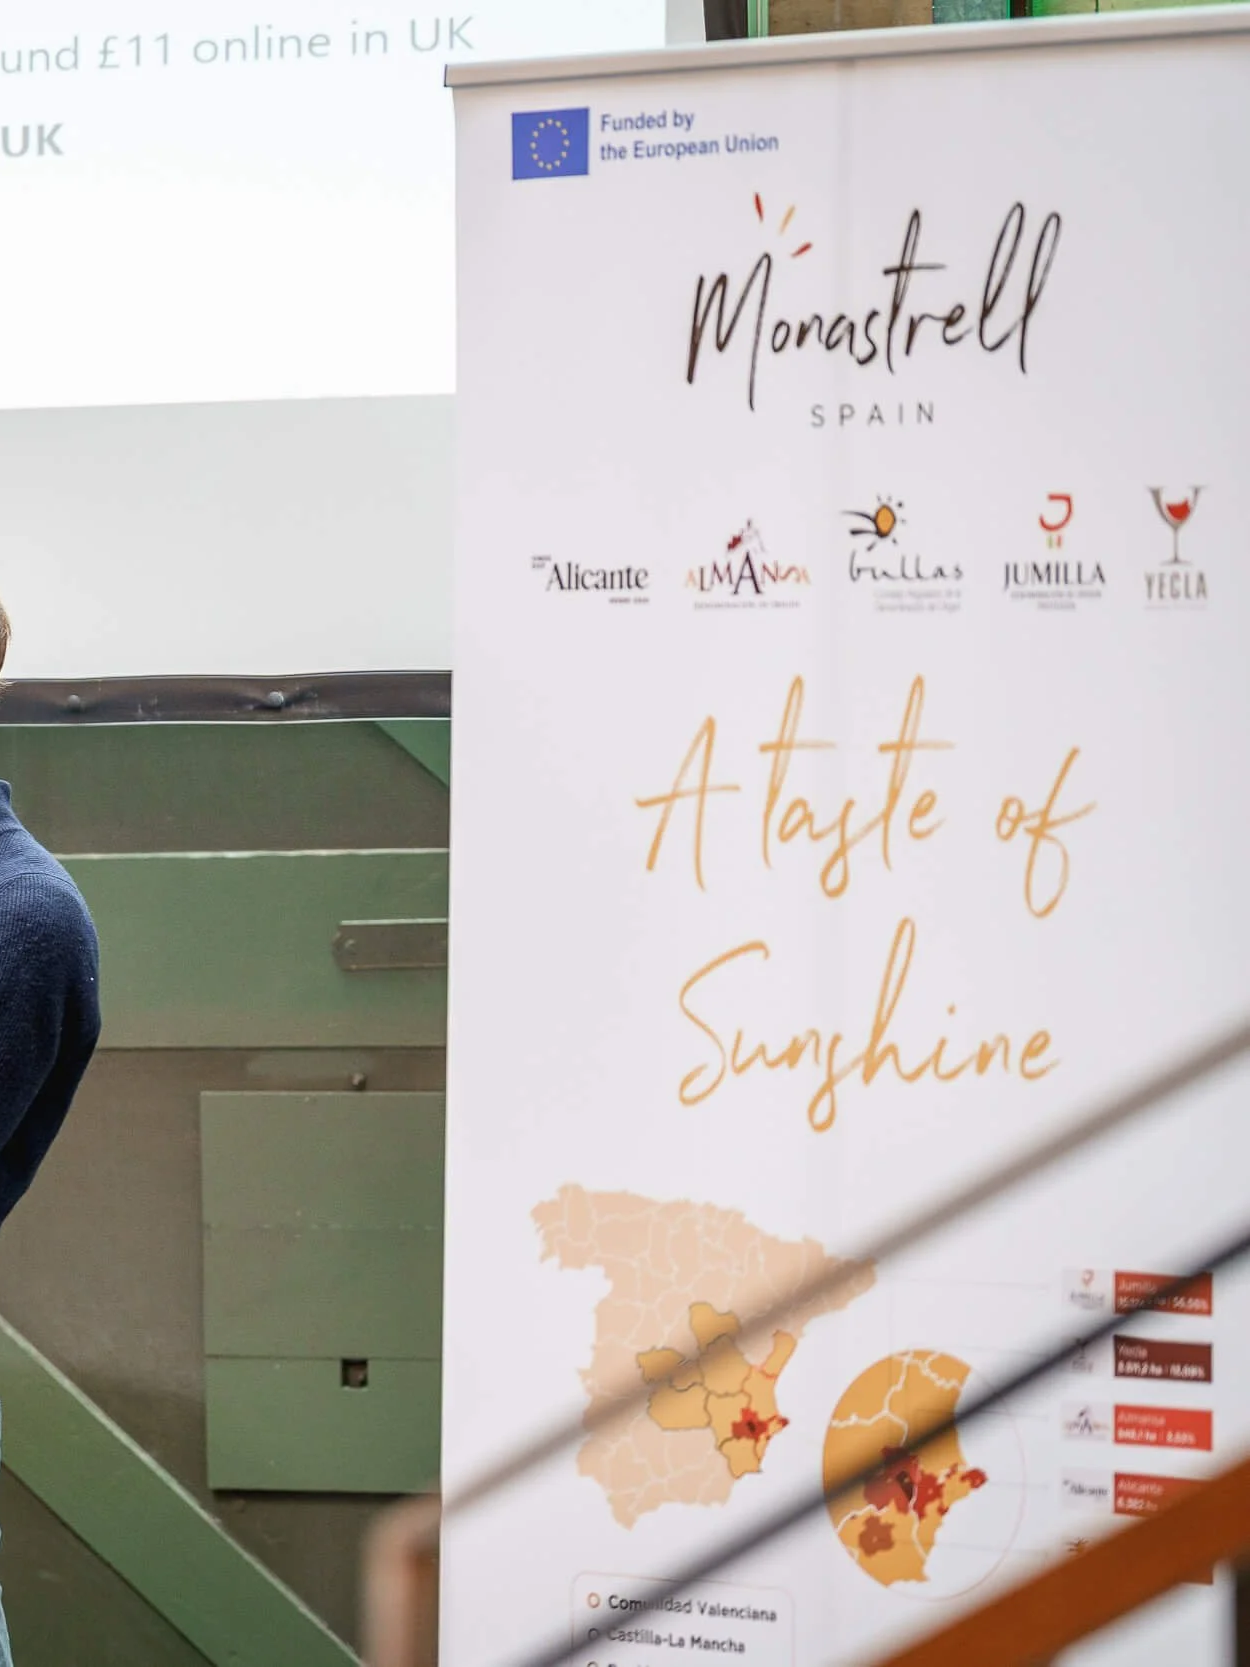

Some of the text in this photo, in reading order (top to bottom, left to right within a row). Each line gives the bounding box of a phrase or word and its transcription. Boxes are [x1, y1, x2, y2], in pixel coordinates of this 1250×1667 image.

[99, 33, 168, 69] £11
[193, 24, 330, 63] online
[352, 20, 388, 55] in
[410, 16, 473, 52] UK
[600, 110, 695, 132] Funded by
[2, 123, 63, 157] UK
[600, 133, 780, 163] the European Union
[687, 202, 1062, 412] Monastrell
[812, 403, 933, 426] SPAIN
[546, 562, 649, 591] Alicante
[1003, 561, 1105, 592] JUMILLA
[1144, 571, 1207, 600] YECLA
[635, 674, 1093, 918] A taste of
[678, 917, 1062, 1134] Sunshine
[698, 1601, 777, 1622] Valenciana
[609, 1628, 746, 1653] Castilla-La Mancha
